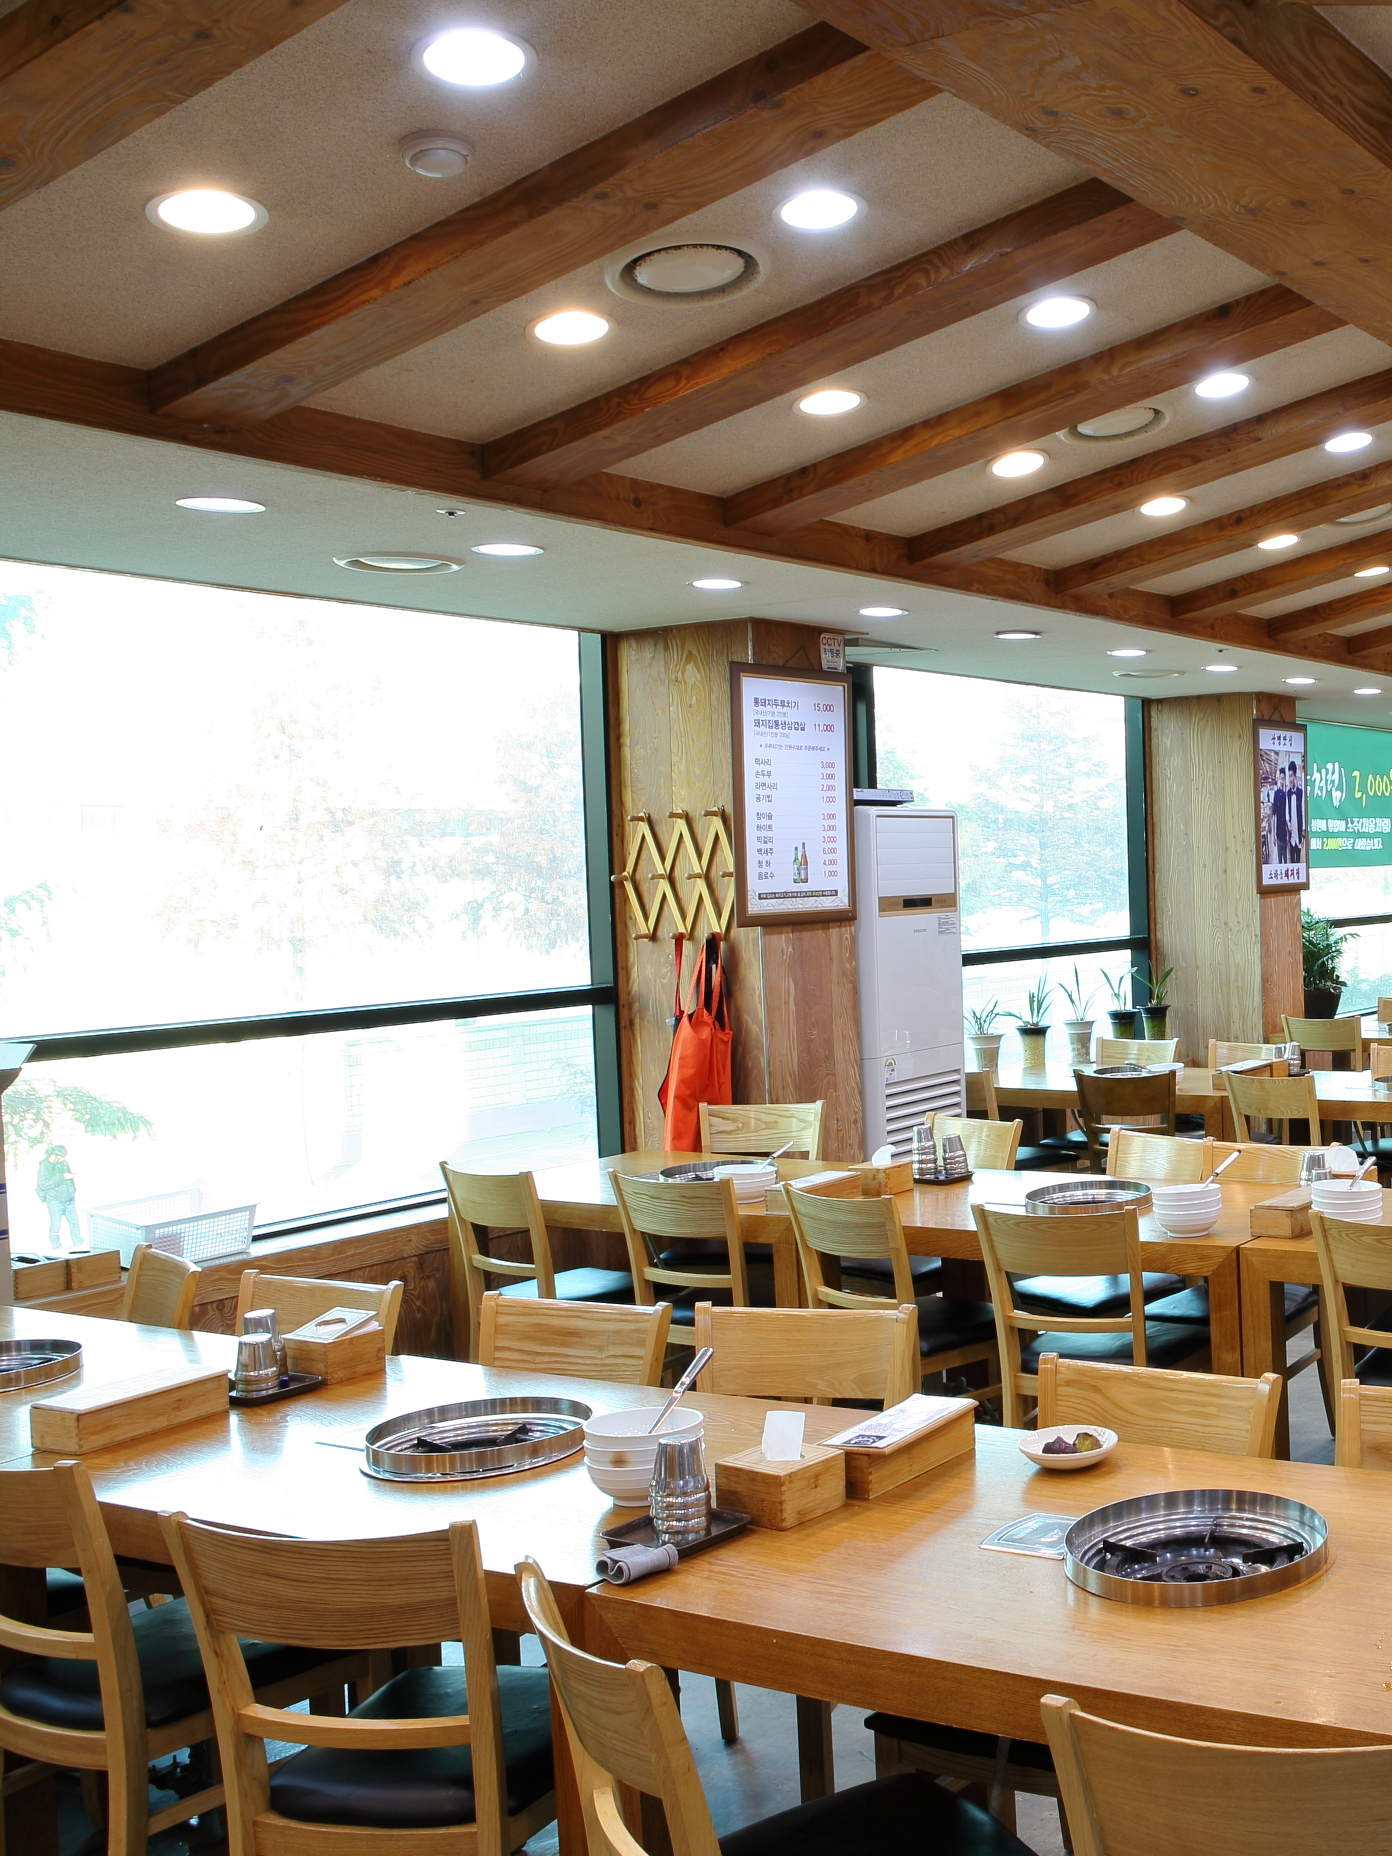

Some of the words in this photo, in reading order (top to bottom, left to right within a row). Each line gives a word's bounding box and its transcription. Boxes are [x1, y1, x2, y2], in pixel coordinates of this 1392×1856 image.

[821, 636, 842, 647] CCTV
[753, 697, 799, 711] 통돼지두루치기
[813, 703, 834, 713] 15,000
[753, 718, 806, 732] 돼지집통생삼겹살
[813, 723, 834, 733] 11,000
[820, 761, 835, 770] 3,000
[754, 769, 772, 779] 손두부
[820, 772, 835, 781] 3,000
[754, 782, 778, 791] 라면사리
[820, 784, 836, 792] 2,000
[1307, 761, 1346, 808] 처럼)
[821, 796, 836, 804] 1,000
[756, 812, 773, 821] 참이슬
[821, 812, 836, 821] 3,000
[756, 823, 774, 833] 하이트
[821, 824, 837, 832] 3,000
[756, 835, 774, 845] 막걸리
[822, 836, 837, 844] 3,000
[756, 847, 774, 857] 백세주
[822, 847, 837, 855] 6,000
[823, 858, 837, 867] 4,000
[757, 871, 775, 880] 음료수
[823, 870, 838, 878] 1,000
